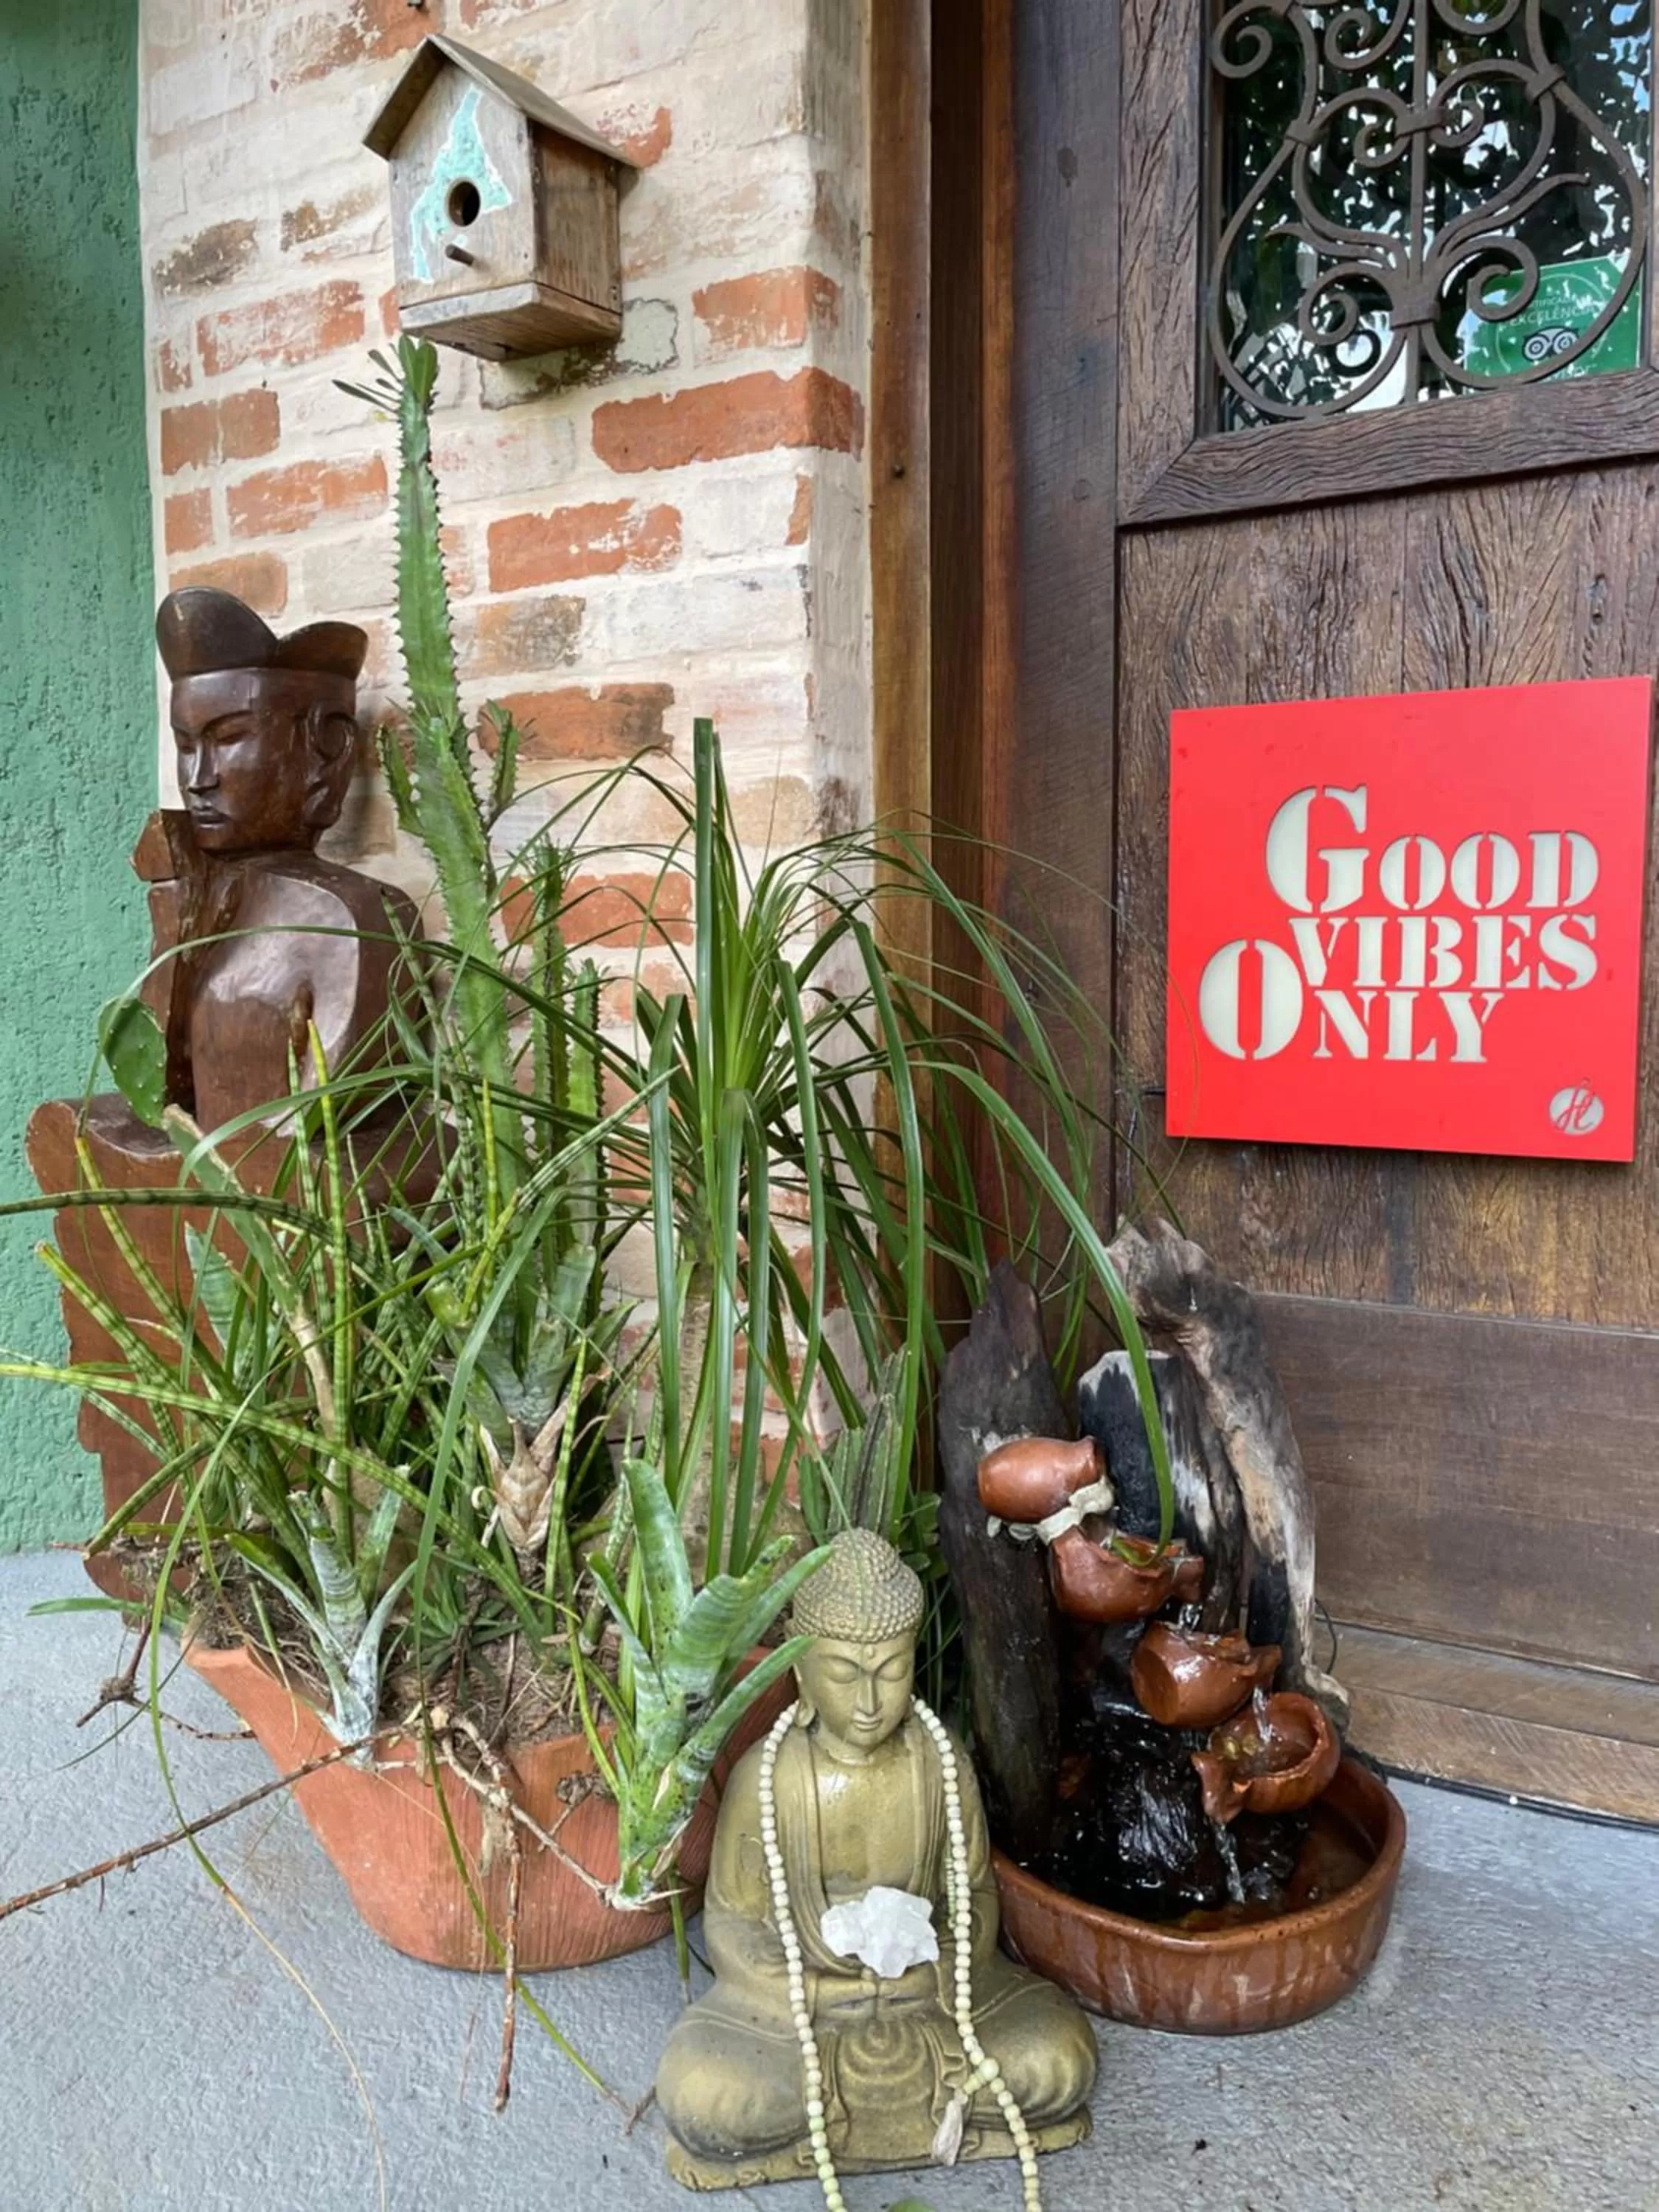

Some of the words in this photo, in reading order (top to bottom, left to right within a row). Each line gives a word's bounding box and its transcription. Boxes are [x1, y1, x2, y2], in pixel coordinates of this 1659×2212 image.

[1266, 784, 1599, 914] GOOD
[1199, 939, 1505, 1062] ONLY
[1288, 914, 1598, 990] VIBES
